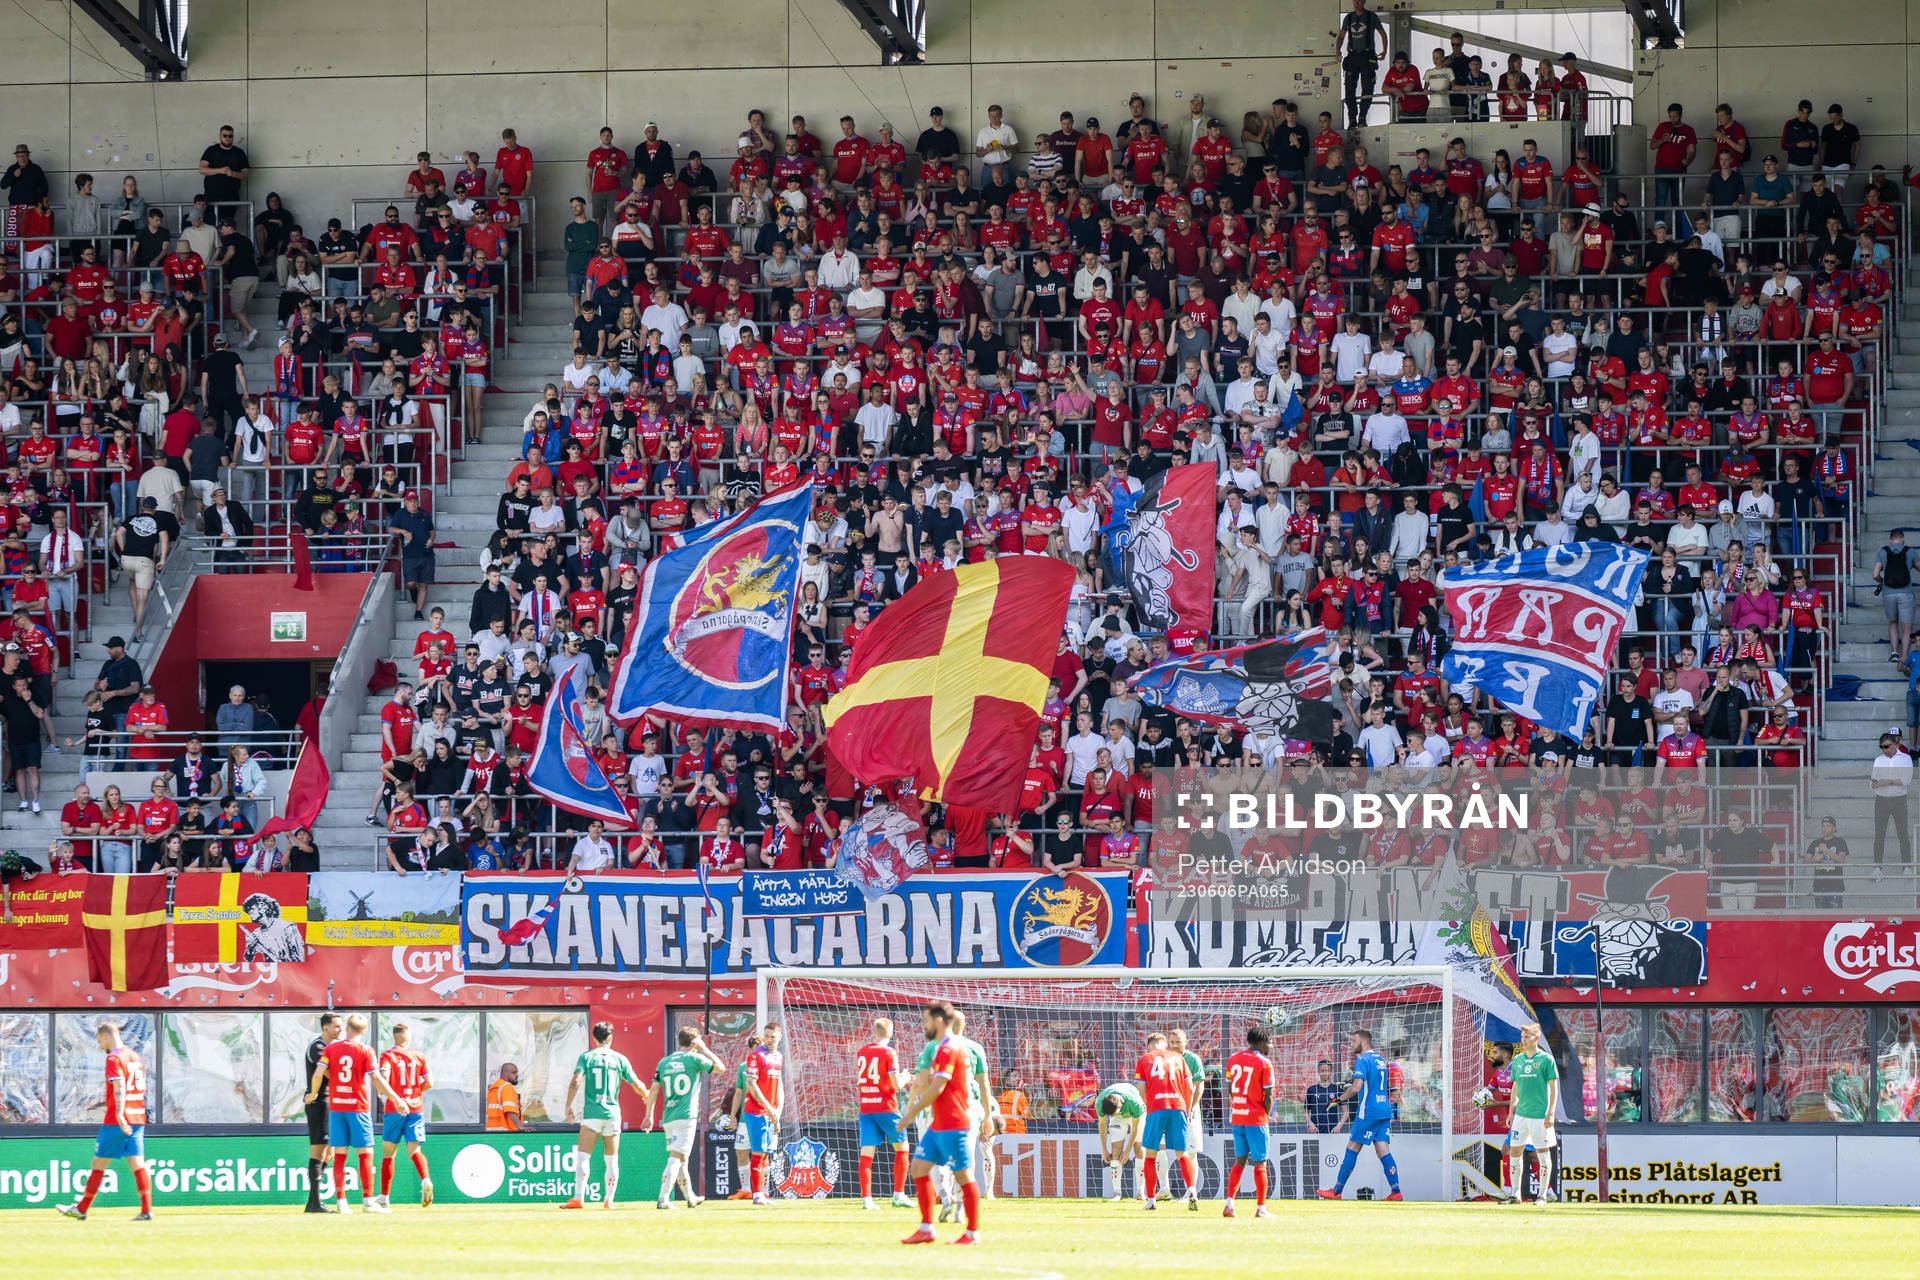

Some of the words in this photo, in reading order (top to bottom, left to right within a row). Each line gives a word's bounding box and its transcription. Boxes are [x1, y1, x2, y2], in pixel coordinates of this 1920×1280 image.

[338, 1055, 354, 1083] 3
[397, 1060, 417, 1087] 11
[858, 1056, 881, 1085] 24
[1230, 1063, 1254, 1095] 27
[663, 1073, 692, 1098] 10
[508, 1144, 578, 1173] Solid
[715, 1146, 729, 1195] SELECT
[1647, 1161, 1782, 1187] Plåtslageri
